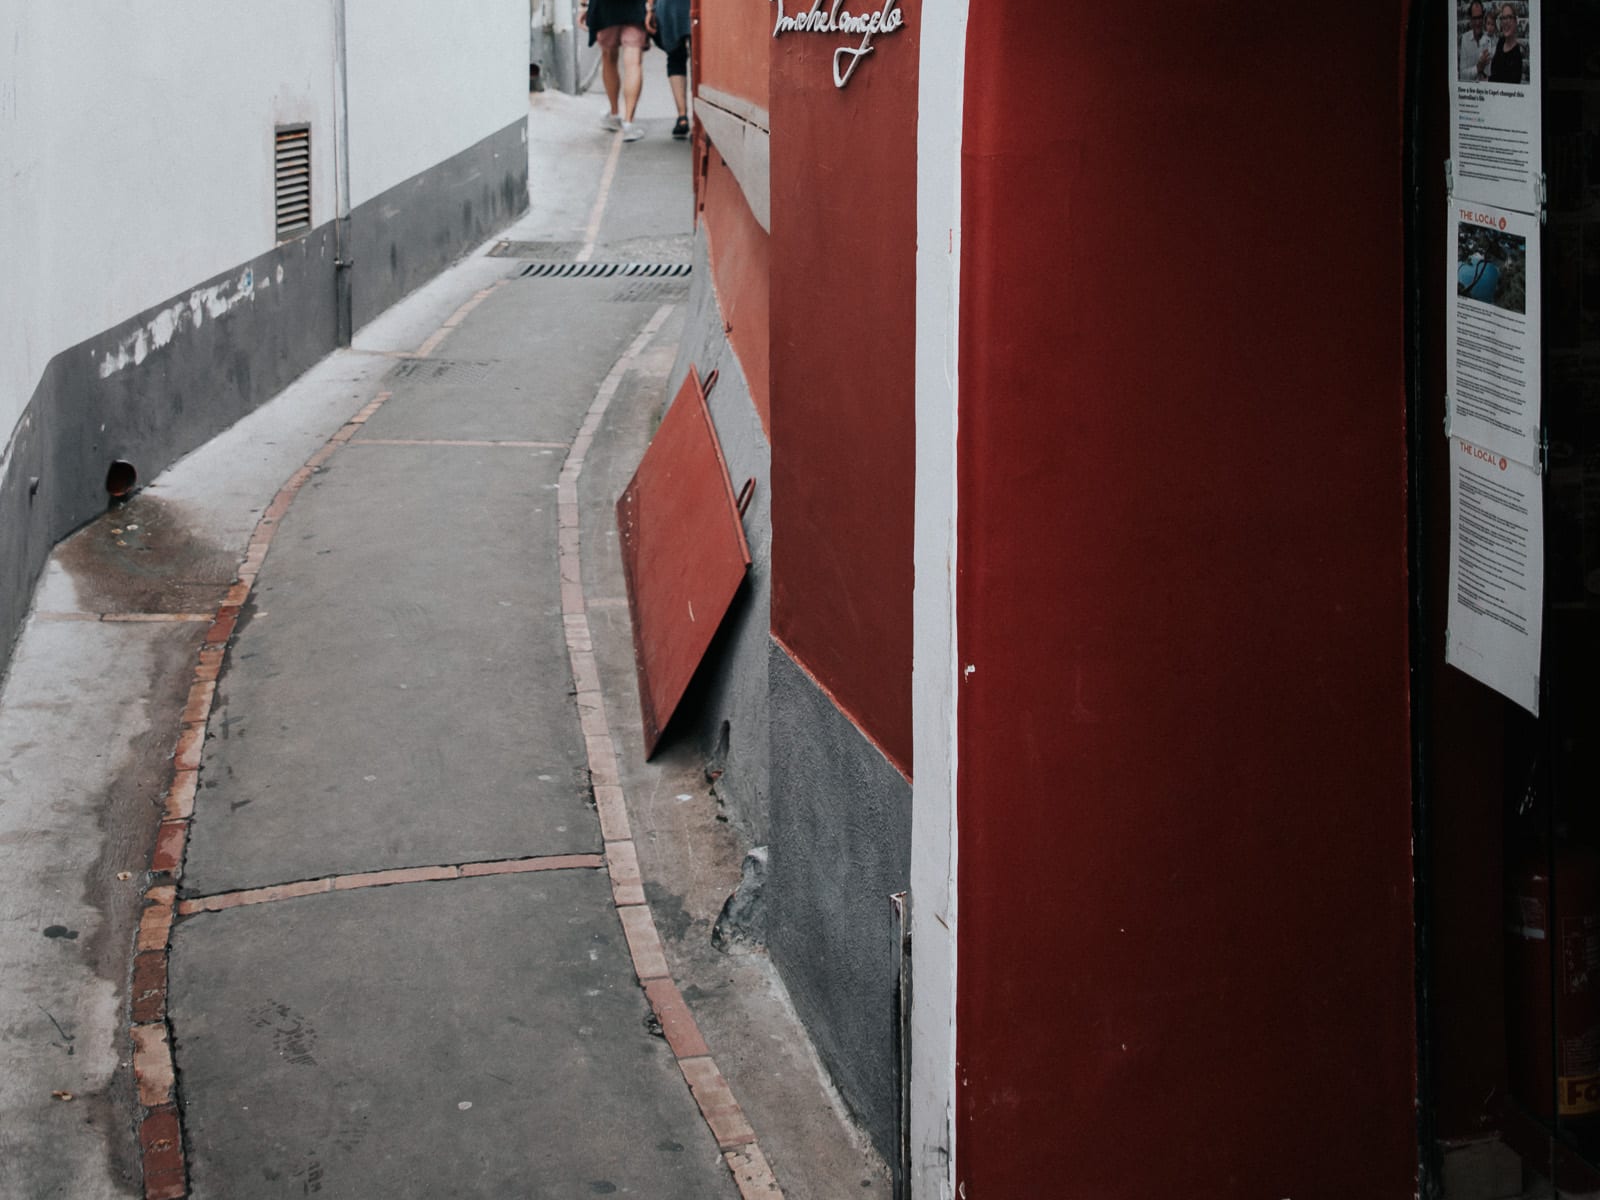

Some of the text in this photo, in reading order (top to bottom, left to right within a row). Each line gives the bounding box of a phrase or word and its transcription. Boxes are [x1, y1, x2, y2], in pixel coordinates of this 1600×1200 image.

[1459, 209, 1497, 227] THE LOCAL
[1459, 441, 1497, 465] THE LOCAL
